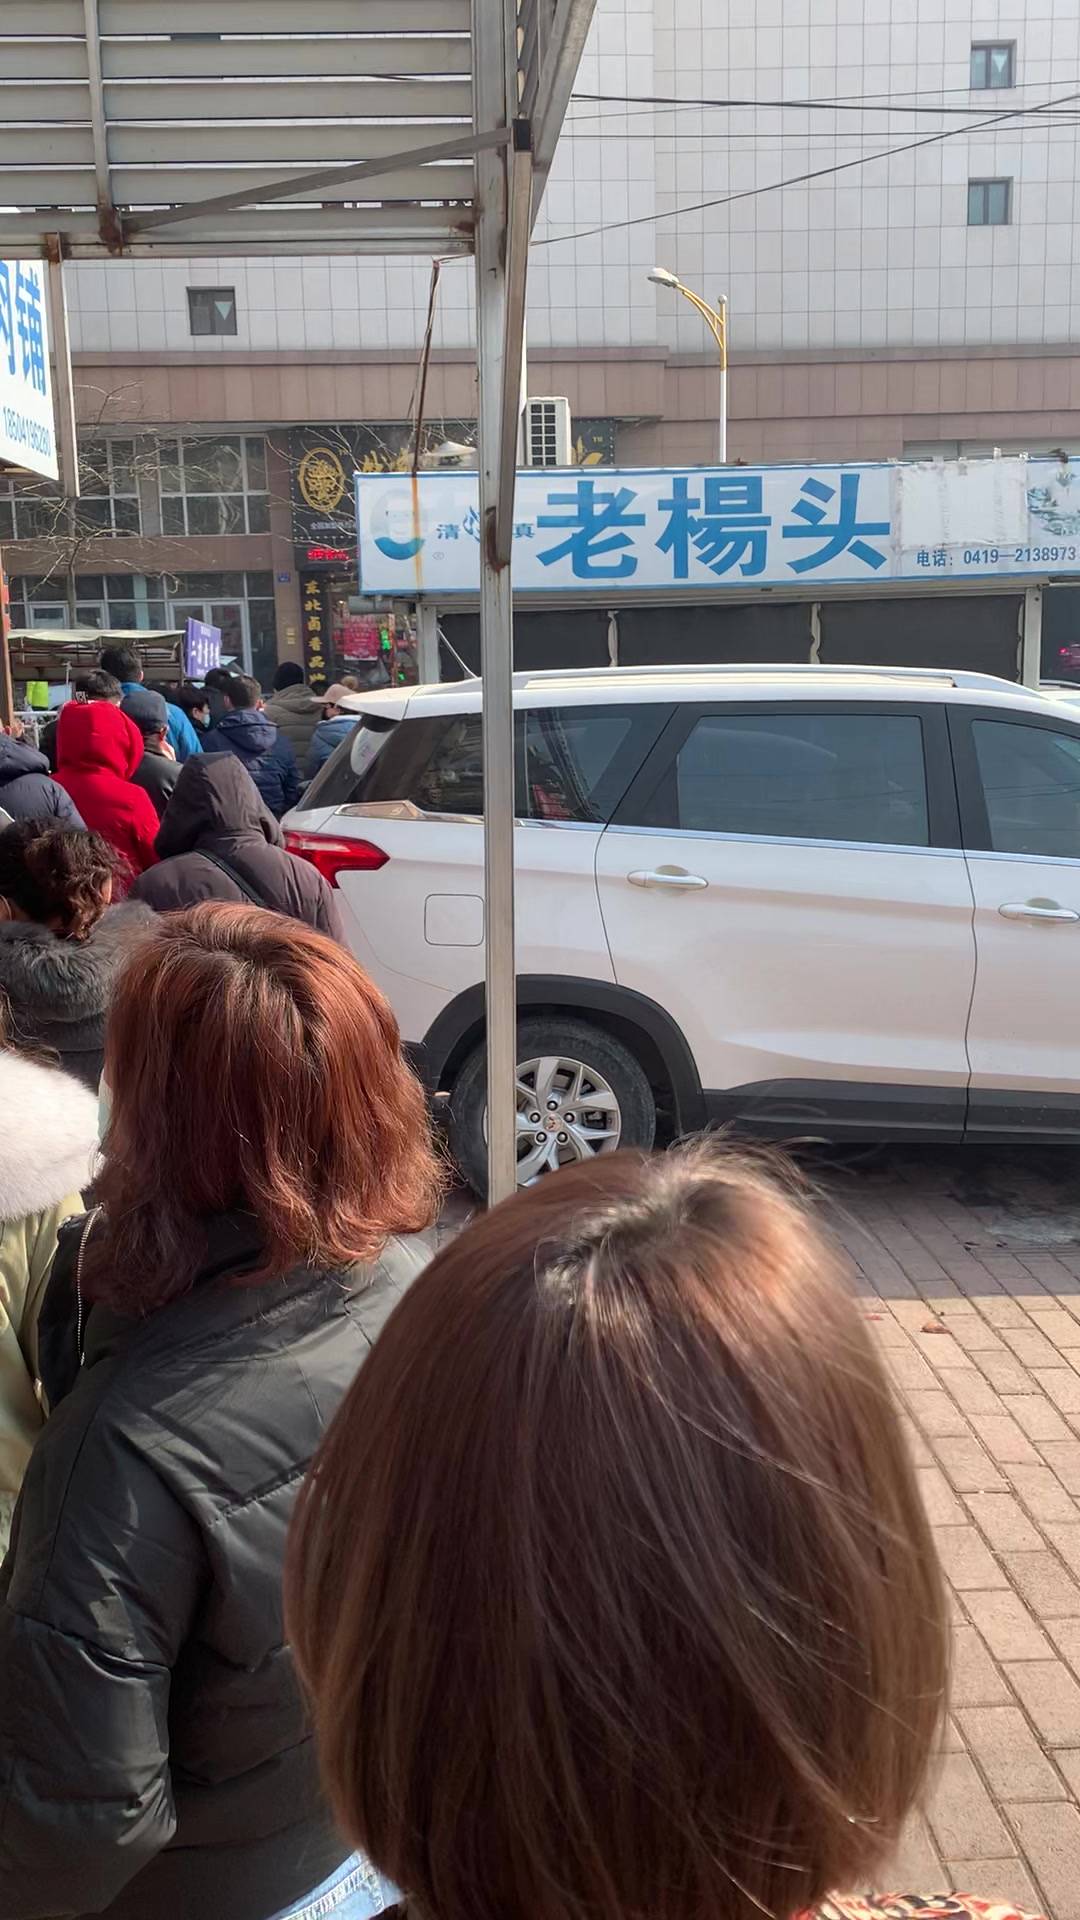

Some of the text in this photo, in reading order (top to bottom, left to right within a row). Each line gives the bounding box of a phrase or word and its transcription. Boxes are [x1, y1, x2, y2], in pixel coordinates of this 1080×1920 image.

[3, 405, 51, 457] 18504196280
[534, 473, 891, 580] 老楊头
